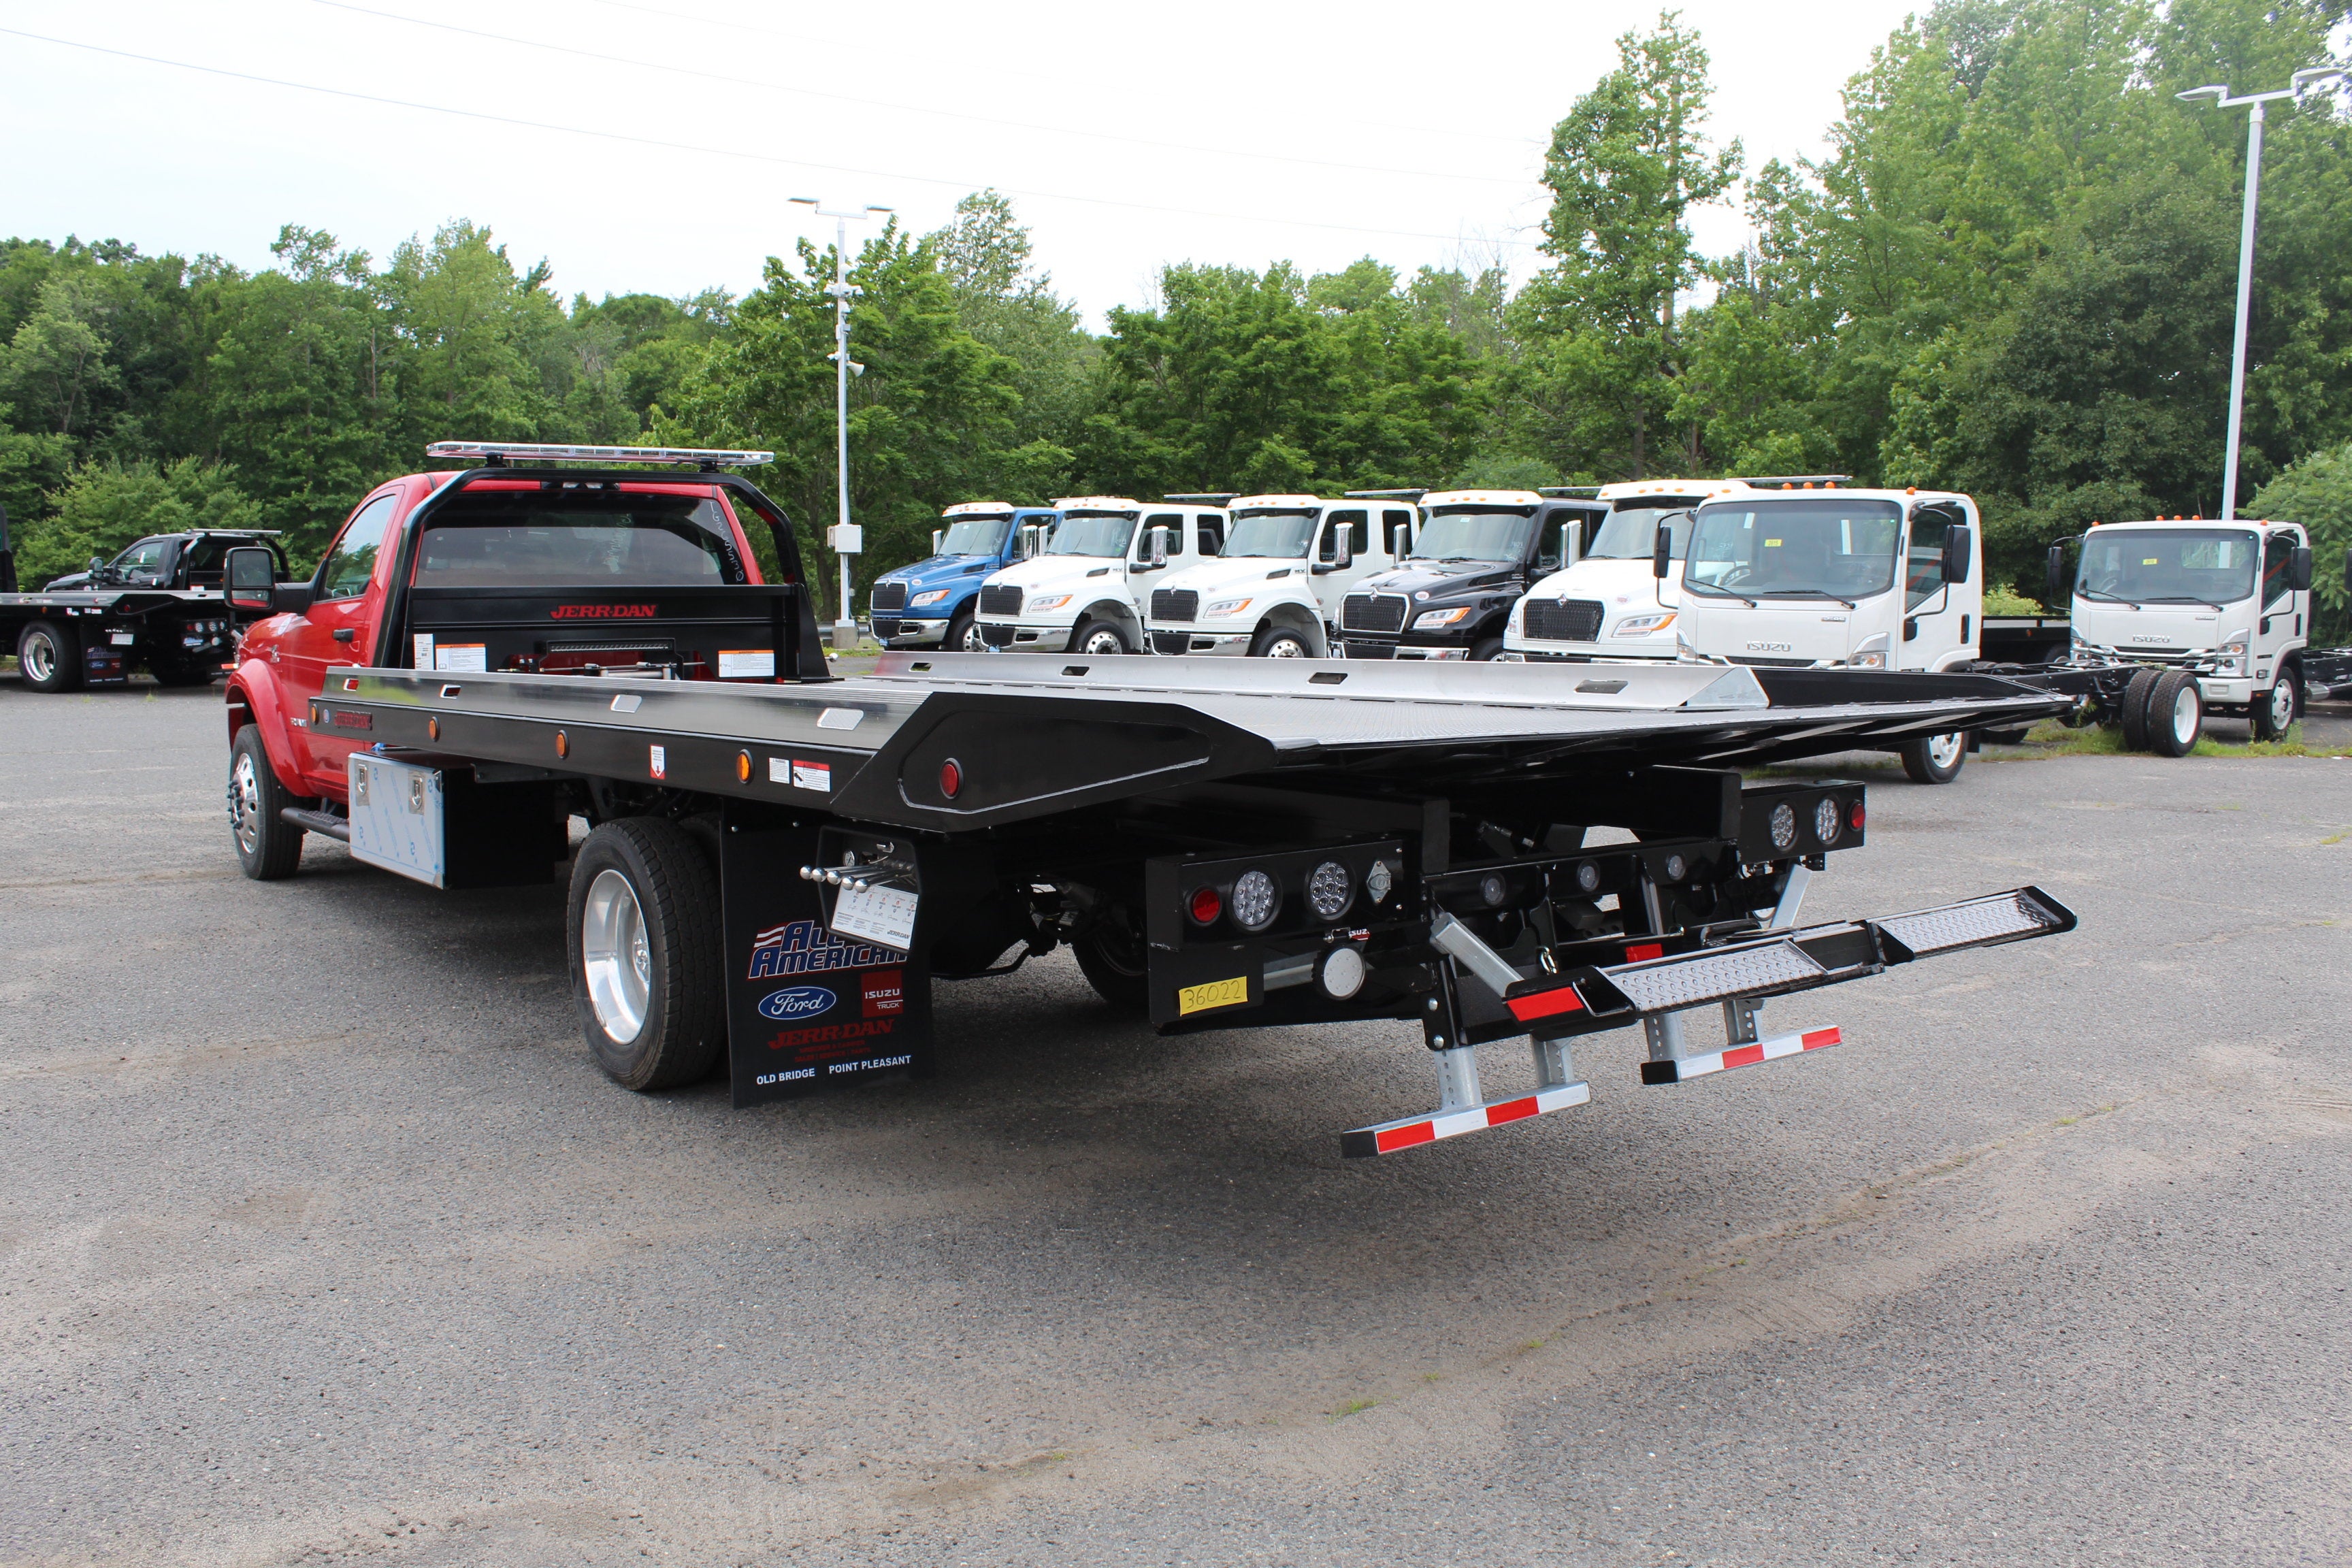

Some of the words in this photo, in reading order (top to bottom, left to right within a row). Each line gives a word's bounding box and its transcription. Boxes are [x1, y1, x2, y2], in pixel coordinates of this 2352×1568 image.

[1746, 640, 1791, 652] ISUZU
[2132, 634, 2170, 643] ISUZU
[865, 988, 900, 999] ISUZU
[1184, 980, 1241, 1009] 36022
[771, 992, 824, 1015] Ford
[756, 1075, 776, 1085] OLD
[779, 1068, 815, 1081] BRIDGE
[829, 1062, 859, 1074] POINT
[862, 1055, 911, 1070] PLEASANT
